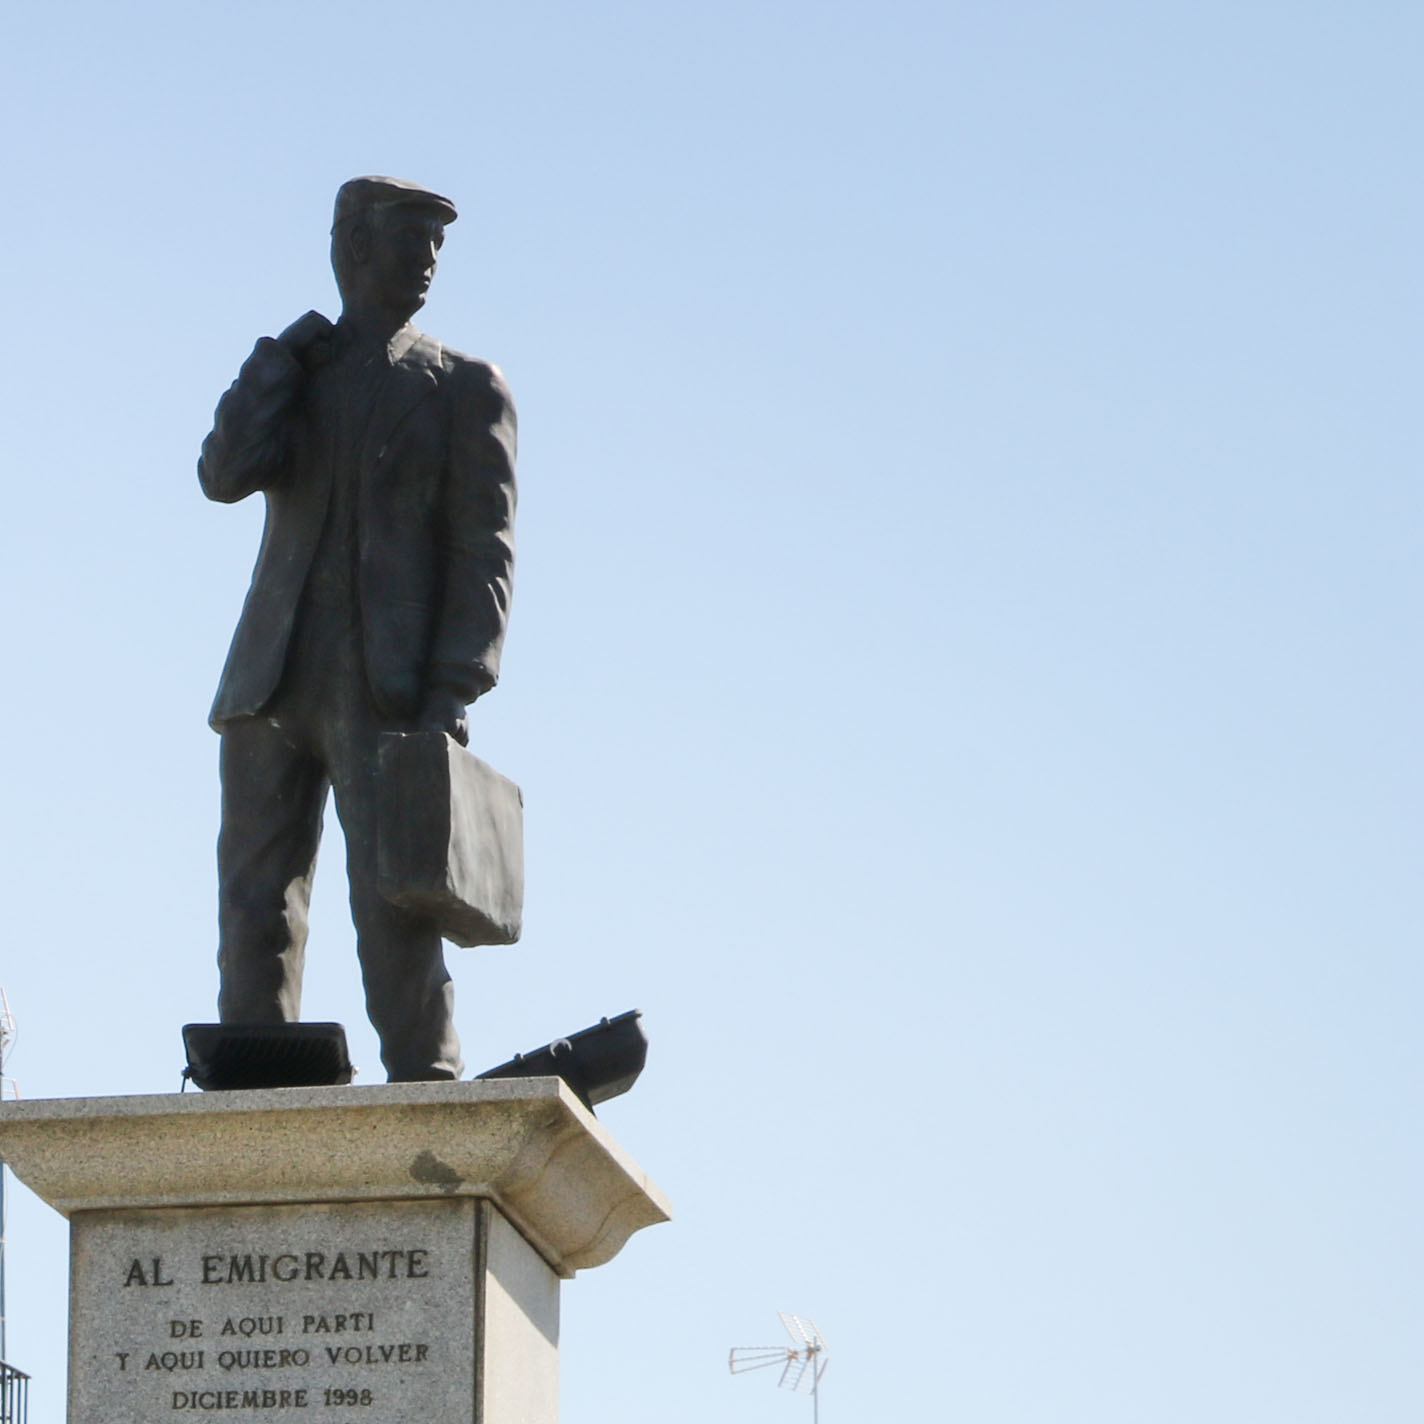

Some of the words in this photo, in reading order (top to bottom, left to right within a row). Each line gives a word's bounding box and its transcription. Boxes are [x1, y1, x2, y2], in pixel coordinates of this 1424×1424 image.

[123, 1258, 174, 1288] AL
[201, 1249, 429, 1285] EMIGRANTE
[170, 1319, 203, 1339] DE
[221, 1316, 284, 1338] AQUI
[302, 1313, 375, 1335] PARTI
[115, 1352, 129, 1371] Y
[145, 1350, 204, 1371] AQUI
[218, 1347, 310, 1371] QUIERO
[324, 1343, 430, 1364] VOLVER
[171, 1389, 309, 1411] DICIEMBRE
[323, 1388, 374, 1408] 1998
